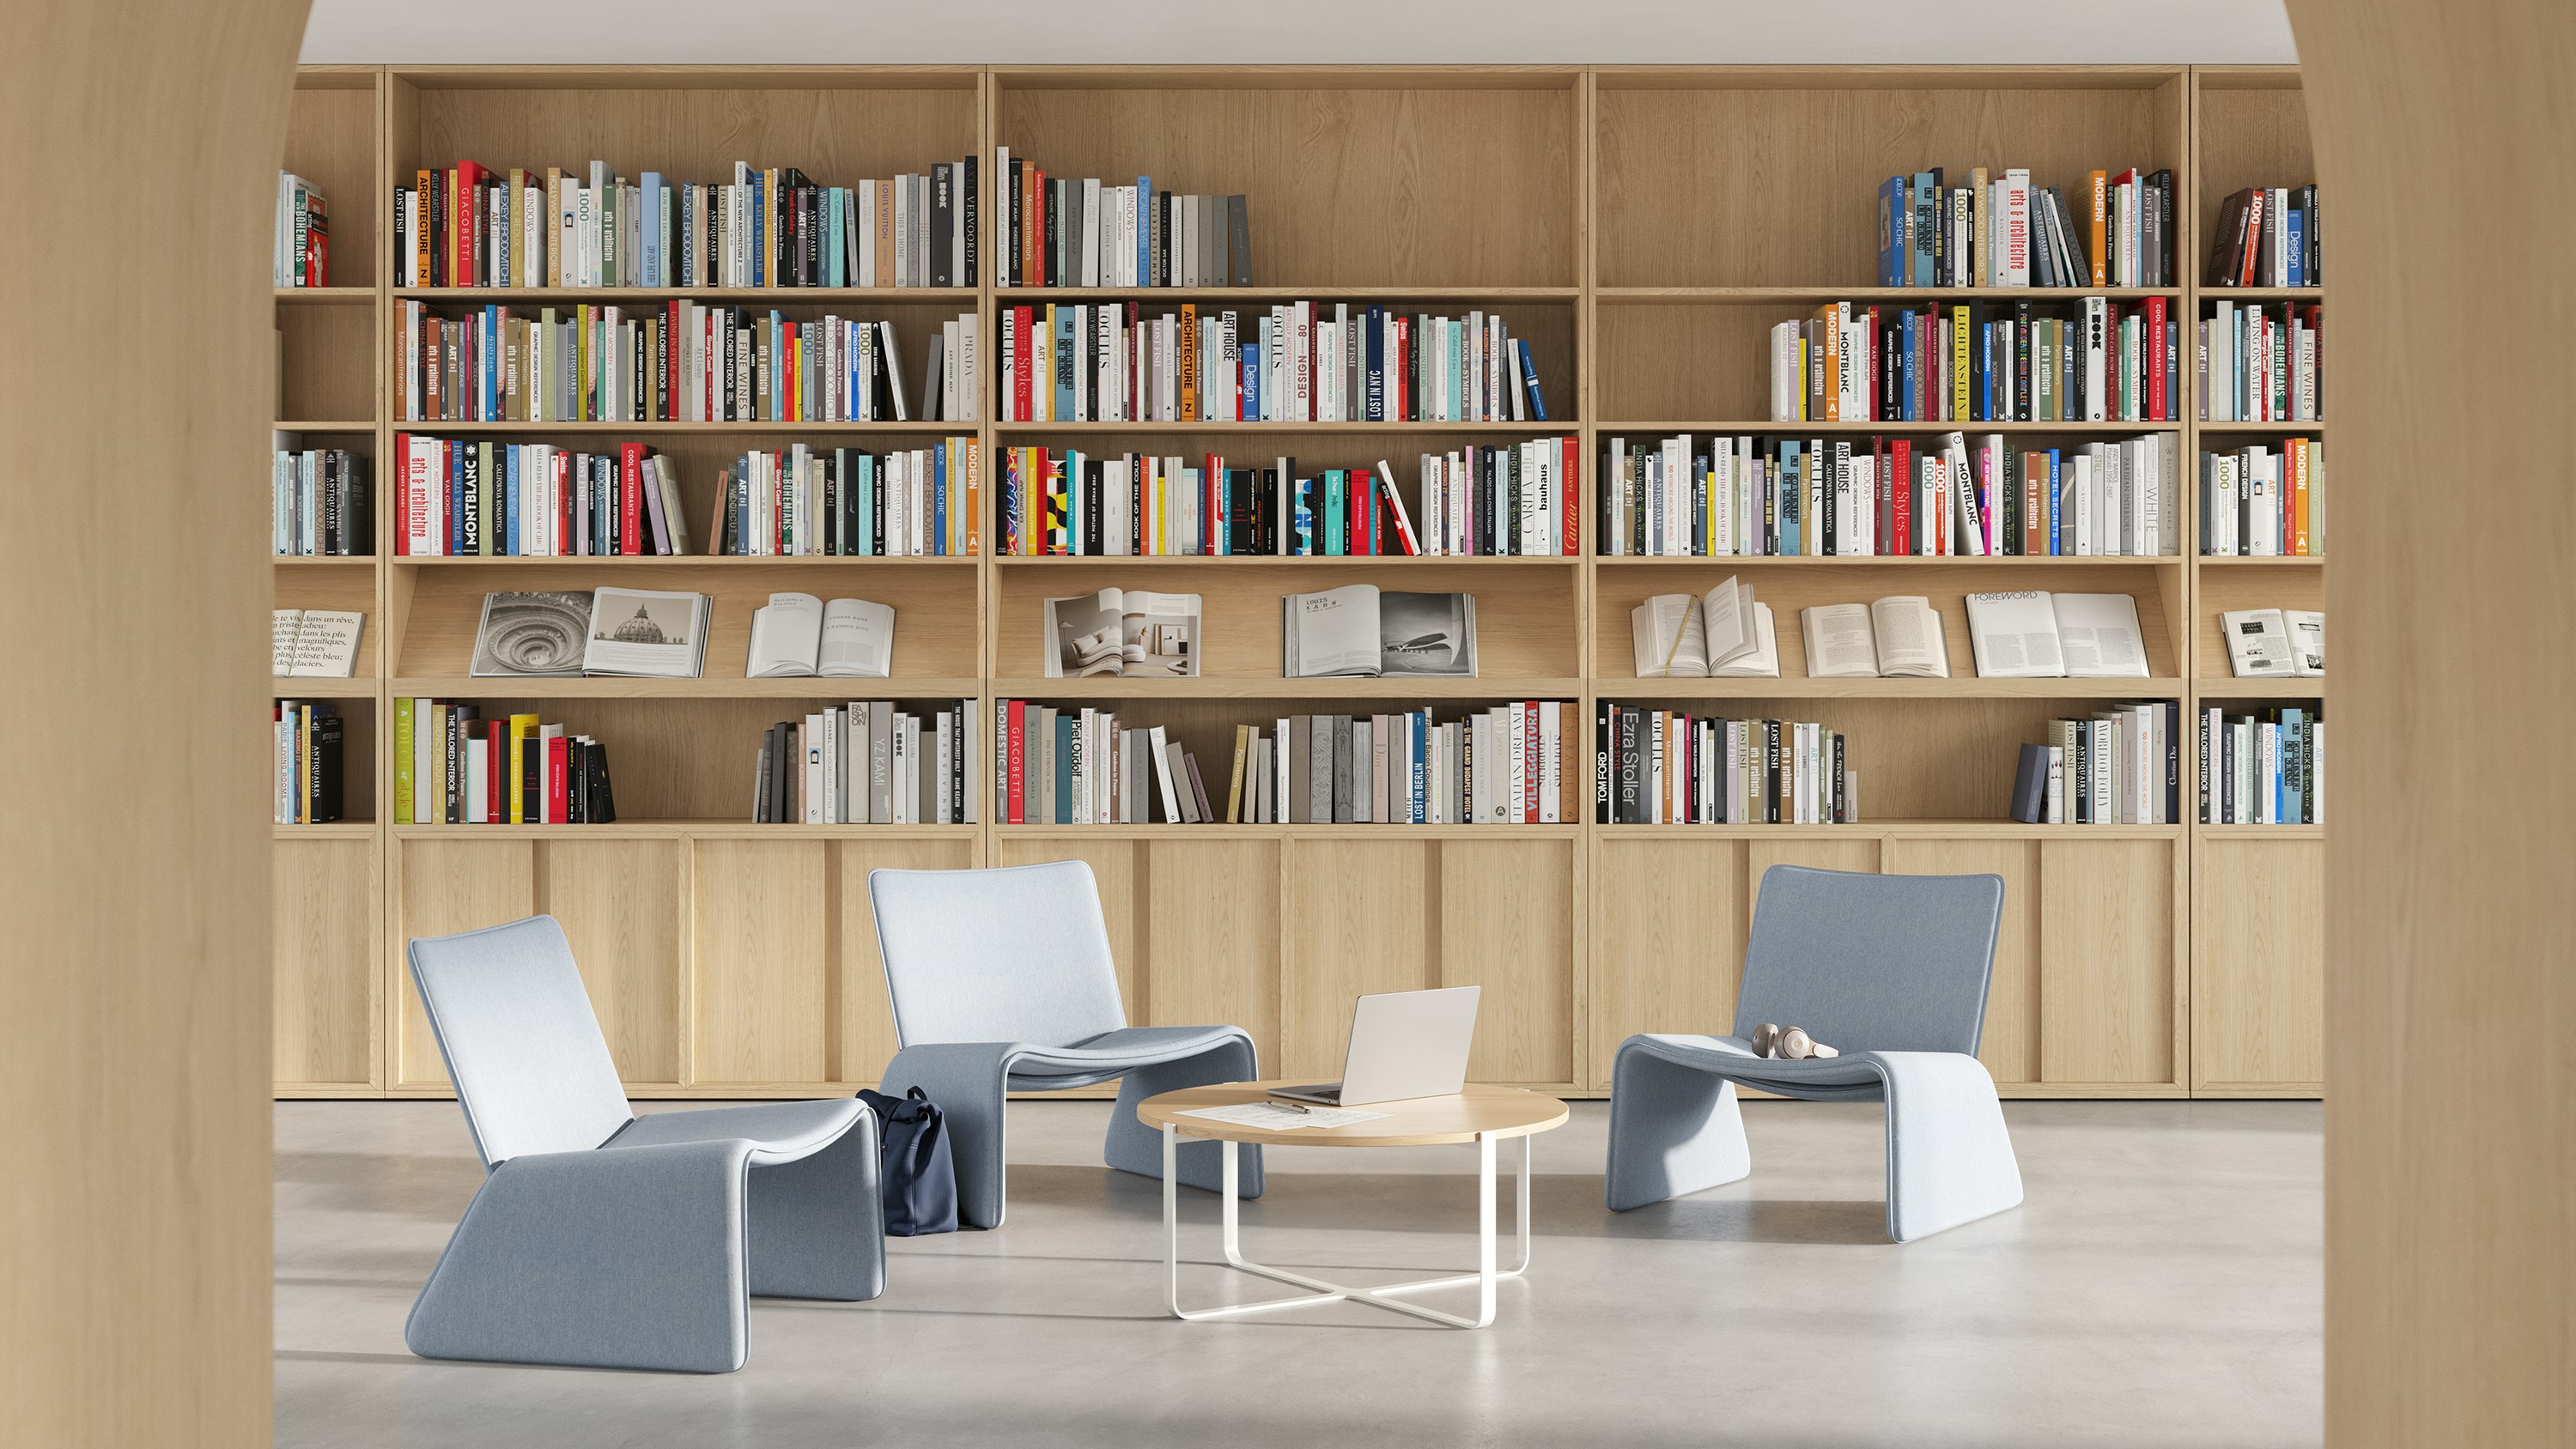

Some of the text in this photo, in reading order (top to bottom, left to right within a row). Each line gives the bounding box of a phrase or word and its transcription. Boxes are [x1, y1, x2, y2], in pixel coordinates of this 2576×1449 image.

[419, 177, 428, 255] ARCHITECTURE
[526, 191, 535, 232] WINDOWS
[580, 192, 589, 221] 1000
[939, 183, 947, 209] BOOK
[1917, 204, 1924, 216] LE
[2009, 190, 2027, 206] arts
[2095, 177, 2104, 221] MODERN
[2251, 195, 2263, 224] 1000
[295, 210, 306, 262] BOHEMIANS
[461, 188, 470, 261] GIACOBETTI
[501, 184, 509, 281] ALEXEY BRODOVITCH
[966, 196, 975, 264] VERVOORDT
[1896, 217, 1903, 227] SO
[1924, 187, 1933, 256] LE CORBUSIER
[2010, 220, 2027, 270] architecture
[2288, 231, 2300, 268] Design
[671, 336, 677, 345] IN
[1099, 315, 1109, 368] OCULUS
[1224, 313, 1234, 361] ART HOUSE
[1399, 341, 1407, 363] Graphic
[2092, 314, 2101, 350] BOOK
[2252, 348, 2260, 362] ON
[964, 336, 973, 376] PRADA
[1015, 357, 1030, 397] Styles
[1297, 355, 1307, 398] DESIGN
[1399, 366, 1407, 385] Design
[1840, 332, 1850, 393] MONTBLANC
[1958, 313, 1966, 410] LICHTENSTEIN
[1370, 370, 1381, 417] LOST IN NYC
[465, 460, 475, 545] MONTBLANC
[1539, 464, 1547, 510] bauhaus
[1957, 462, 1977, 525] MONTBLANC
[1564, 500, 1577, 549] Cartier
[2146, 488, 2157, 533] WHITE
[1306, 597, 1327, 605] LOUIS
[1974, 591, 2038, 601] FOREWORD
[998, 706, 1006, 791] DOMESTIC ART
[1072, 721, 1081, 778] Piet Oudolf
[1375, 743, 1386, 768] Dior
[1513, 712, 1522, 816] ITALIAN DREAM
[1527, 708, 1537, 811] VILLEGGIATURA
[1623, 712, 1638, 804] Ezra Stoller
[1652, 720, 1662, 773] OCULUS
[2098, 724, 2108, 807] WORLD OF FOLLY
[875, 757, 885, 785] KAMI
[1598, 752, 1607, 803] TOM FORD
